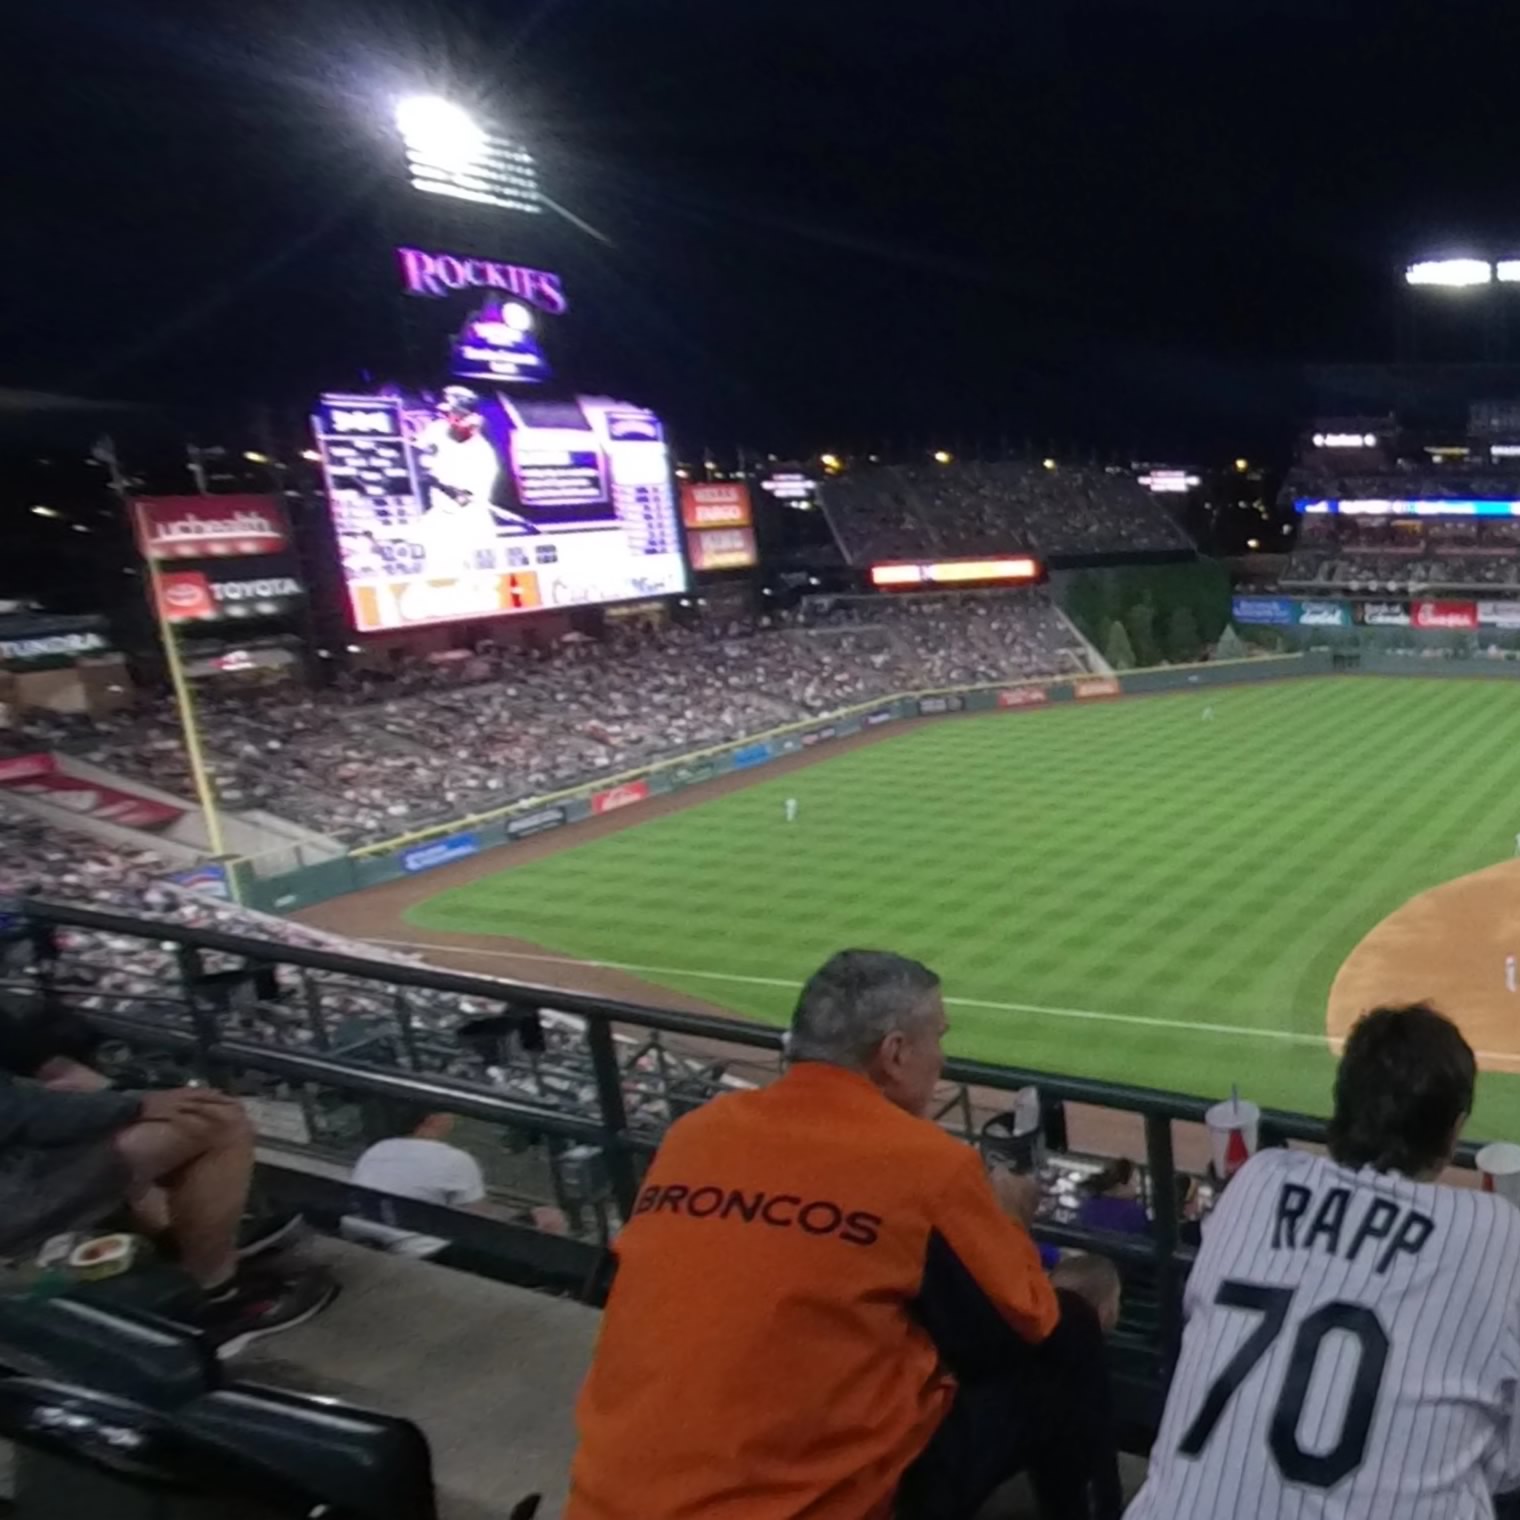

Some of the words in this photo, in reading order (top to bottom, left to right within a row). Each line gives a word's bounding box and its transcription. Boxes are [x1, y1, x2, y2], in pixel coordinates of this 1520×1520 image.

[397, 247, 567, 314] ROCKIES
[155, 511, 274, 538] uchealth
[209, 577, 301, 600] TOYOTA
[633, 1184, 883, 1246] BRONCOS
[1271, 1182, 1435, 1275] RAPP
[1177, 1279, 1390, 1490] 70
